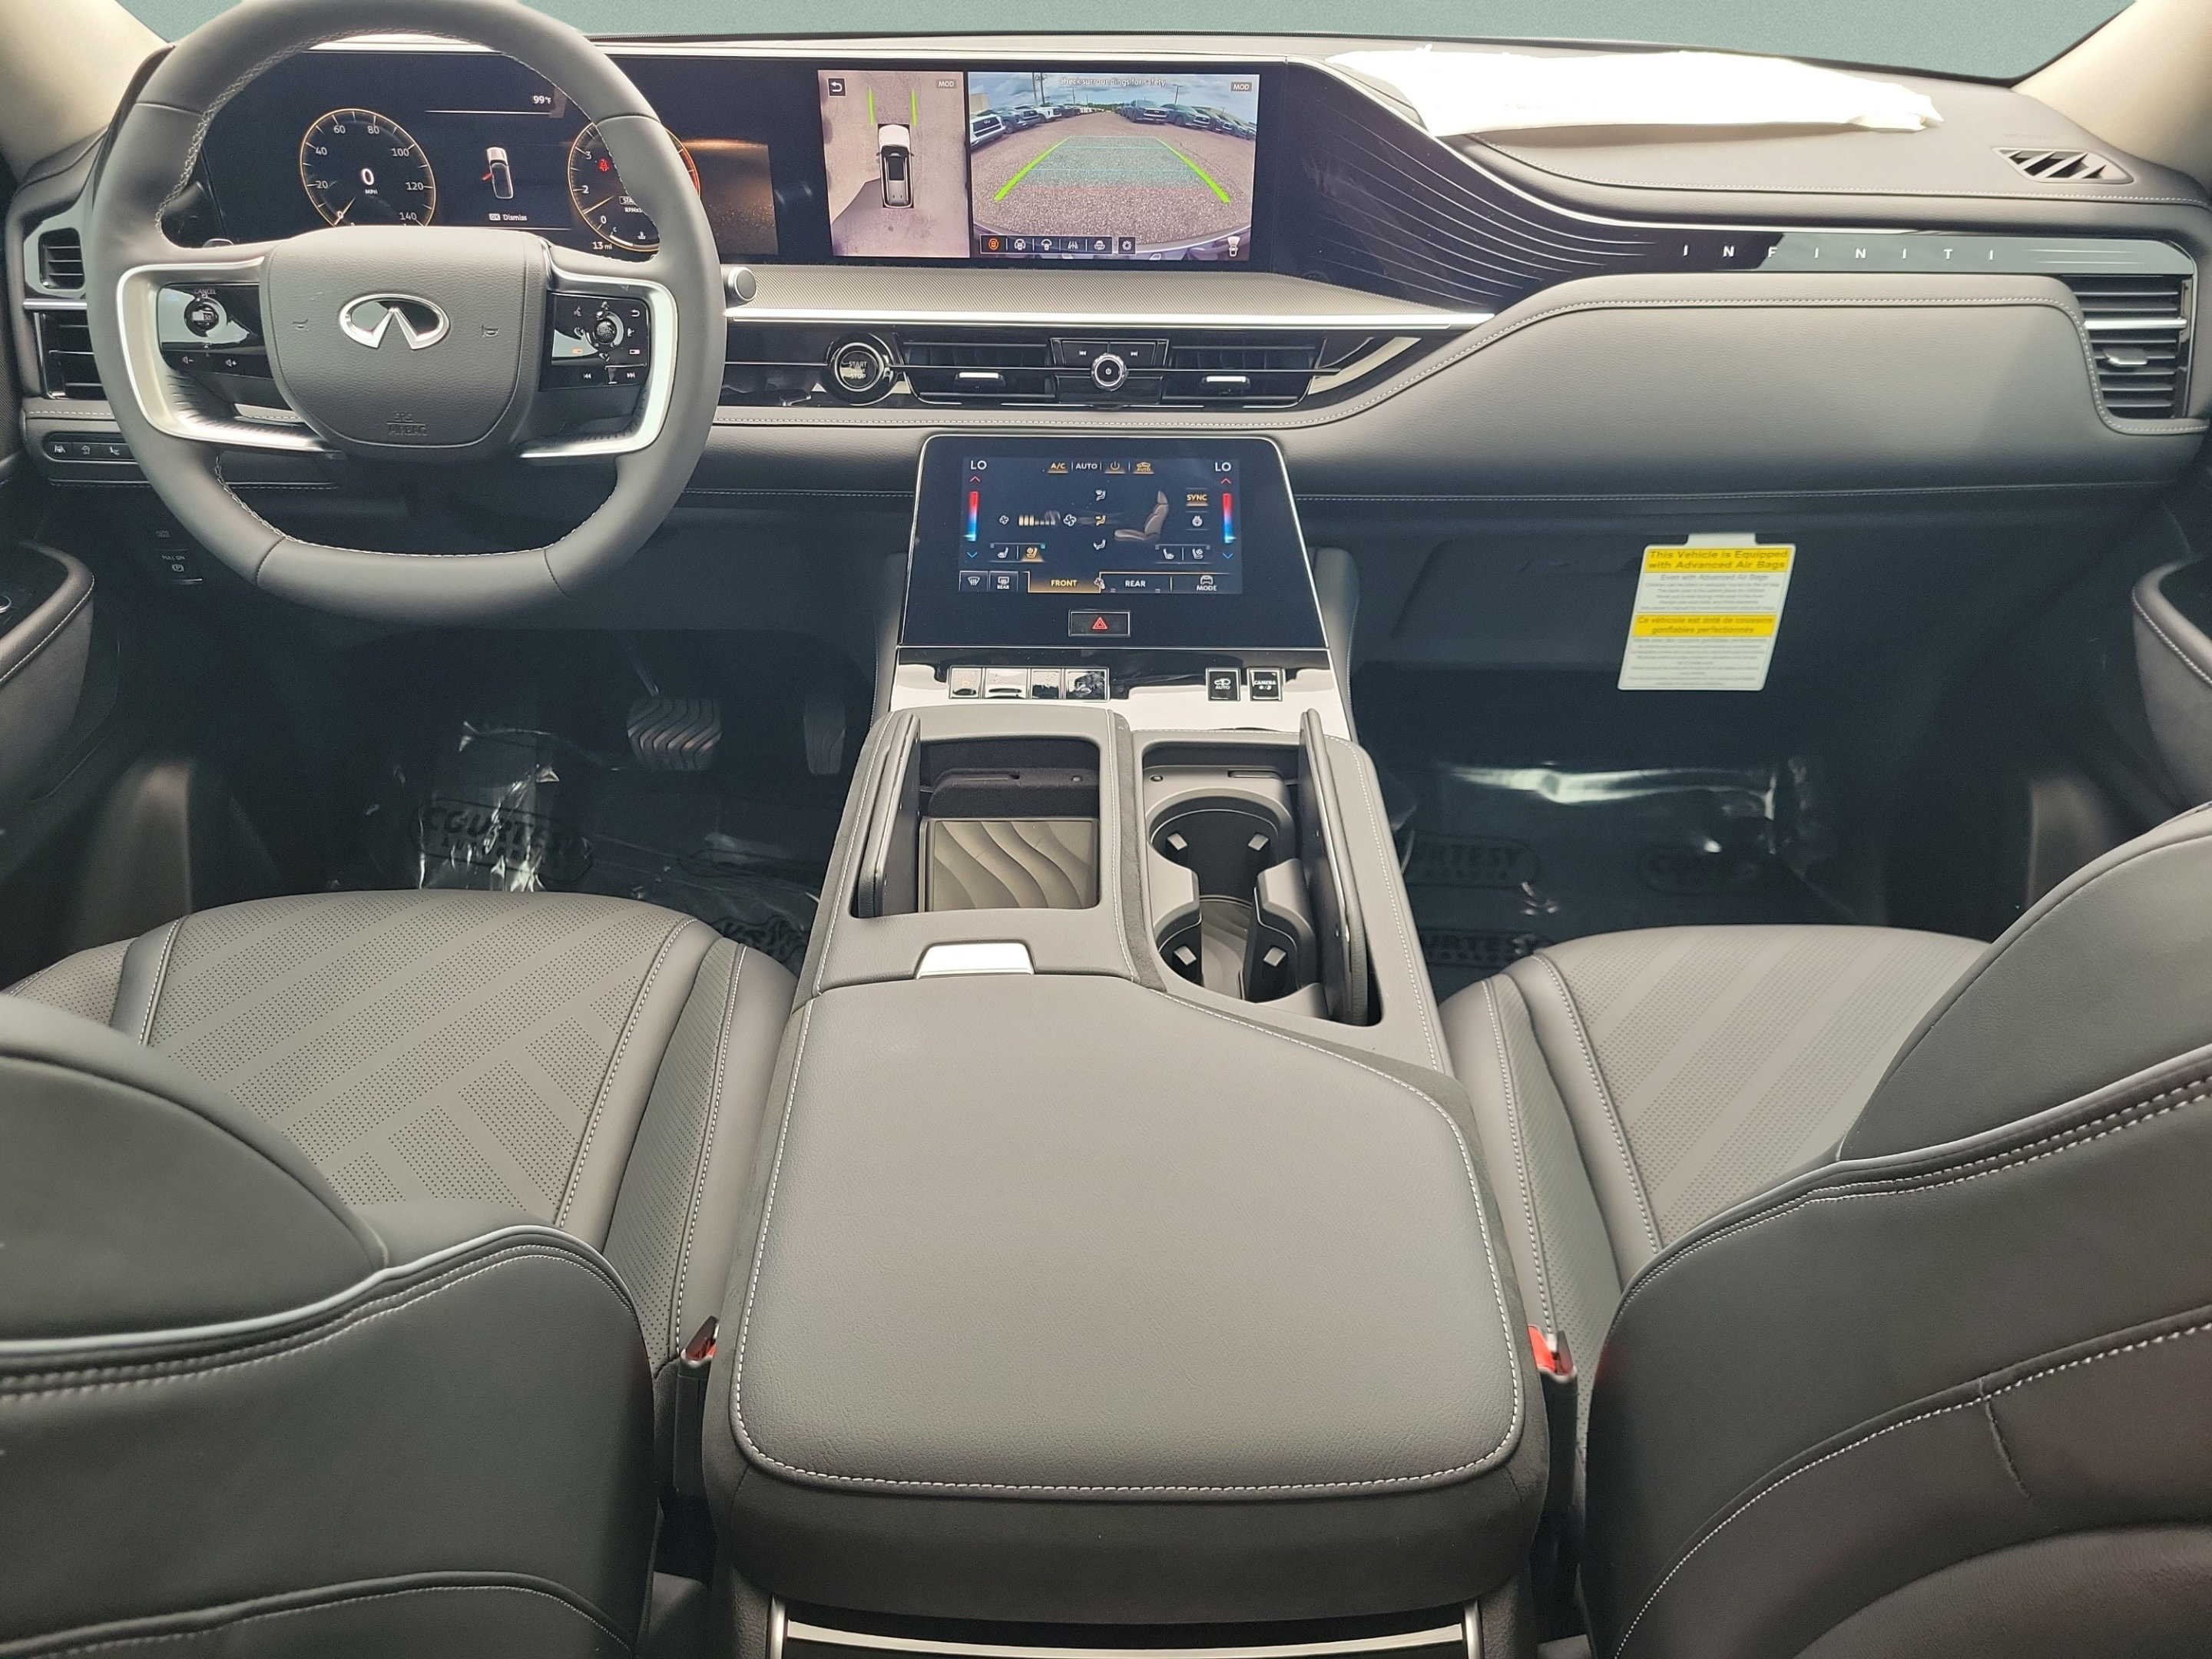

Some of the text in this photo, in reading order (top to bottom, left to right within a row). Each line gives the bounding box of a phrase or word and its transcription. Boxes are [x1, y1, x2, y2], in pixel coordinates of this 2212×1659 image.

[1082, 77, 1130, 87] surroundings
[1144, 78, 1166, 88] safety
[333, 125, 346, 134] 60
[367, 125, 379, 134] 80
[315, 147, 327, 156] 40
[391, 148, 409, 157] 100
[585, 151, 592, 160] 3
[361, 168, 374, 186] 0
[316, 180, 329, 189] 20
[405, 182, 424, 190] 120
[582, 184, 590, 194] 2
[336, 210, 343, 219] 0
[399, 212, 417, 220] 140
[600, 215, 607, 224] 0
[592, 242, 604, 250] 13
[1683, 244, 1994, 260] INFINITI
[970, 460, 987, 470] LO
[1215, 462, 1232, 472] LO
[1651, 550, 1788, 560] This Vehicle is Equipped
[1675, 561, 1732, 569] Advanced
[1757, 561, 1785, 571] Bags
[1652, 626, 1754, 635] gonflables perfectionnés
